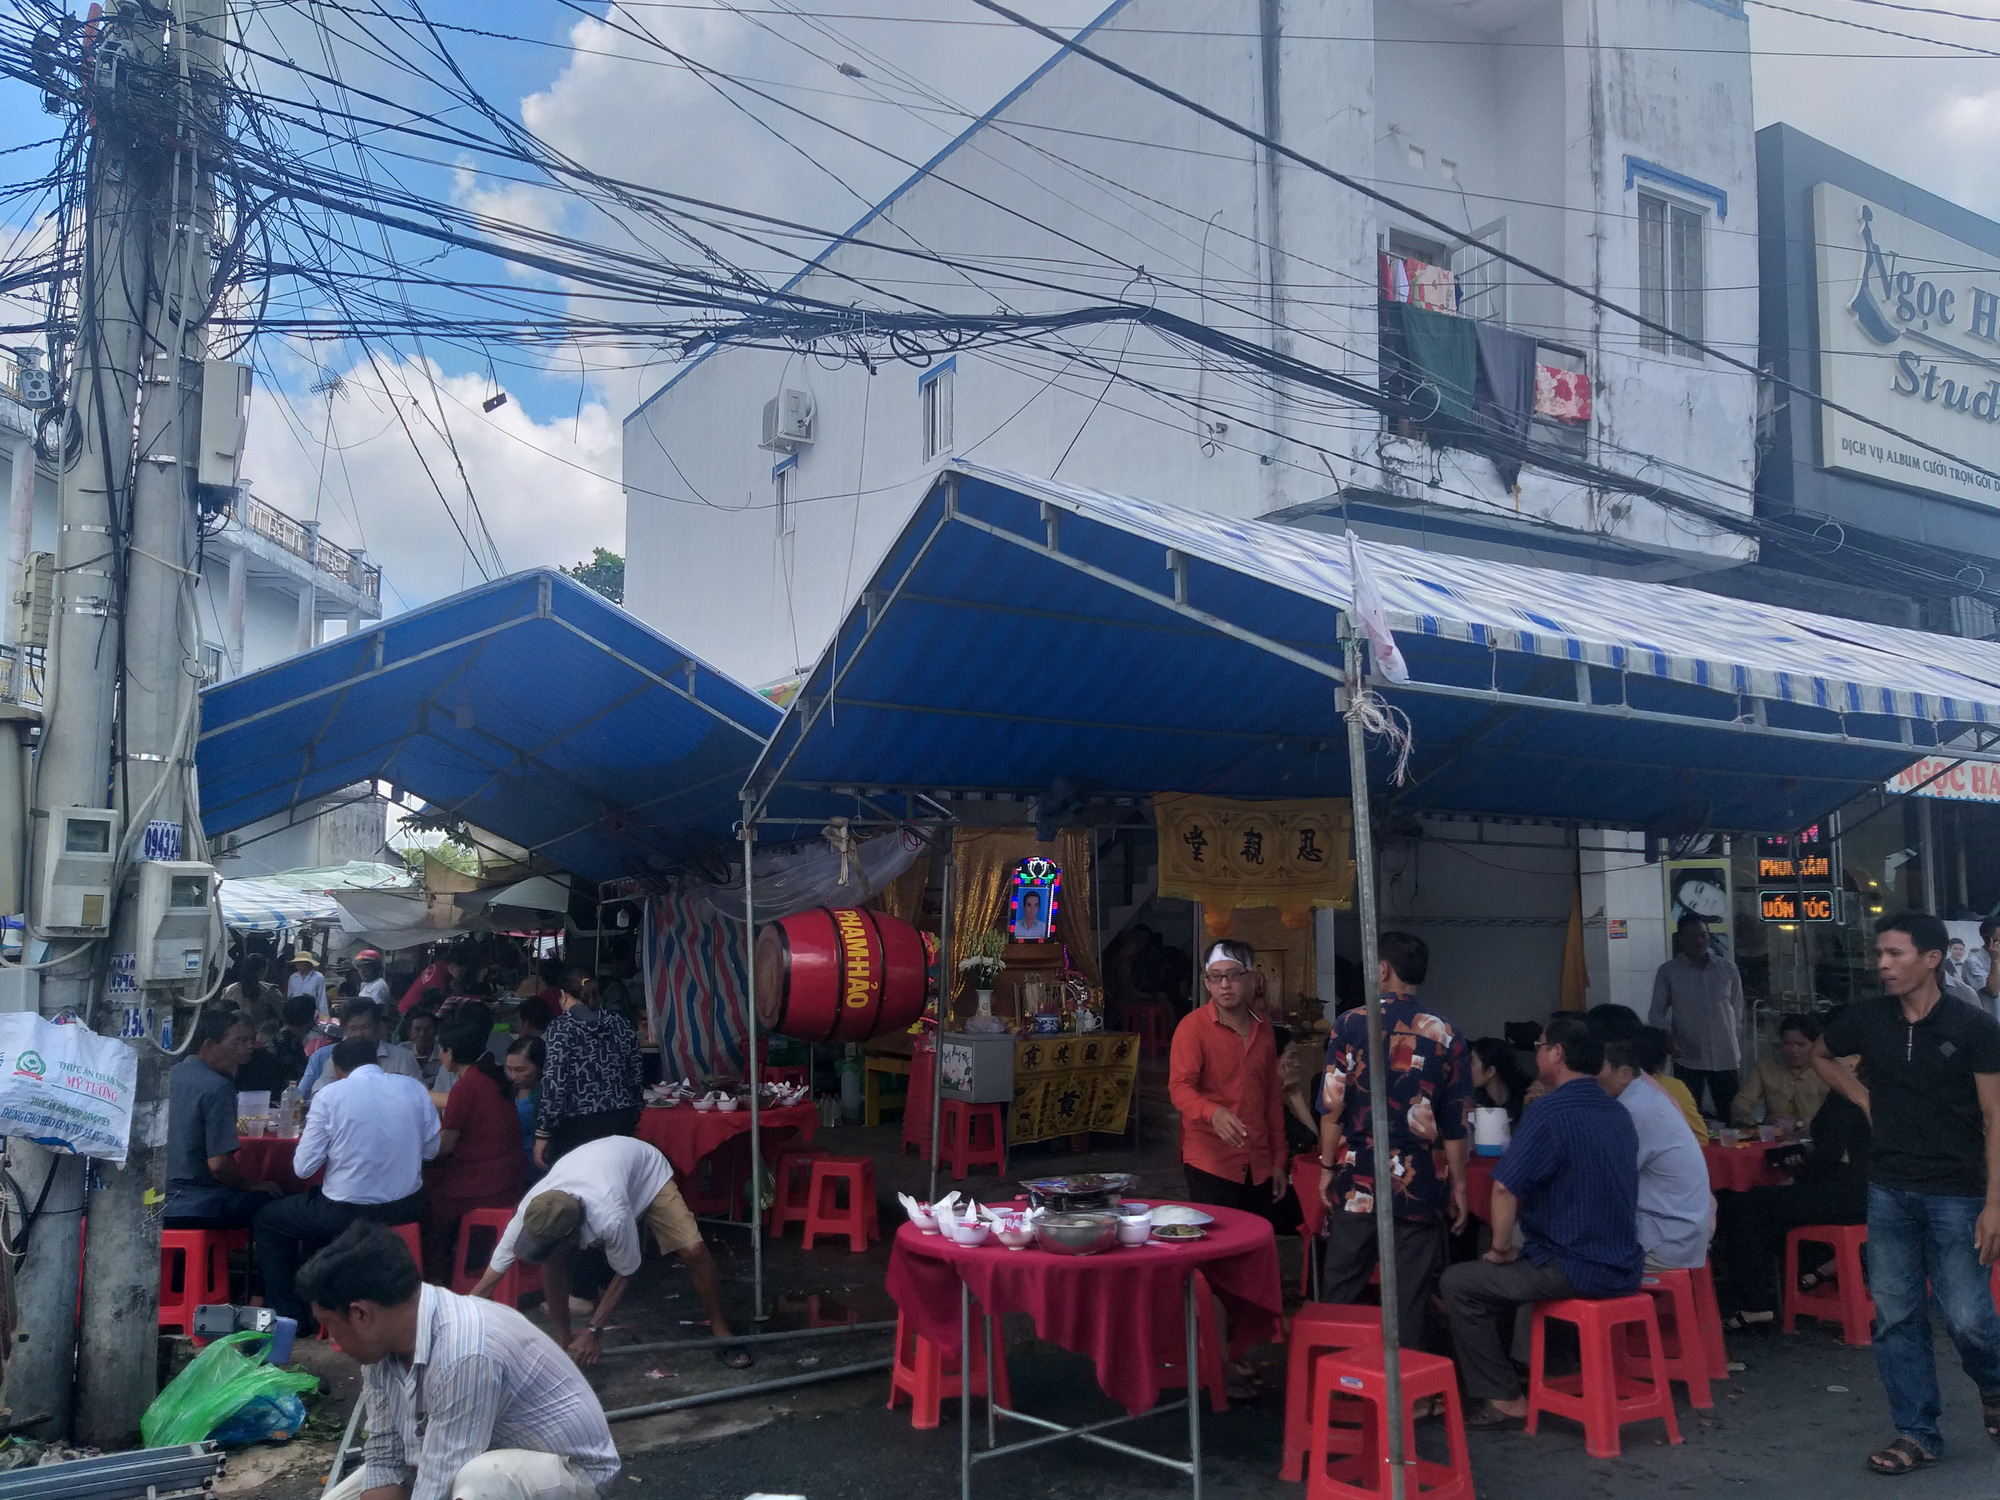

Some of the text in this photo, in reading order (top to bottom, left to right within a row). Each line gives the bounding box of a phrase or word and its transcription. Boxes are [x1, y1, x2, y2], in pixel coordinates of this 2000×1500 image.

[1851, 205, 1956, 345] Ngọc
[1841, 437, 1867, 456] DỊCH
[1869, 444, 1884, 463] VỤ
[1886, 450, 1921, 470] ALBUM
[1922, 459, 1948, 478] CƯỚI
[1949, 466, 1974, 486] TRỌN
[1975, 474, 1992, 490] GÓI
[1898, 760, 1965, 796] NGỌC
[1762, 894, 1831, 918] UỐN TÓC
[24, 1112, 40, 1124] CHO
[39, 1115, 55, 1128] HEO
[55, 1119, 72, 1132] CON
